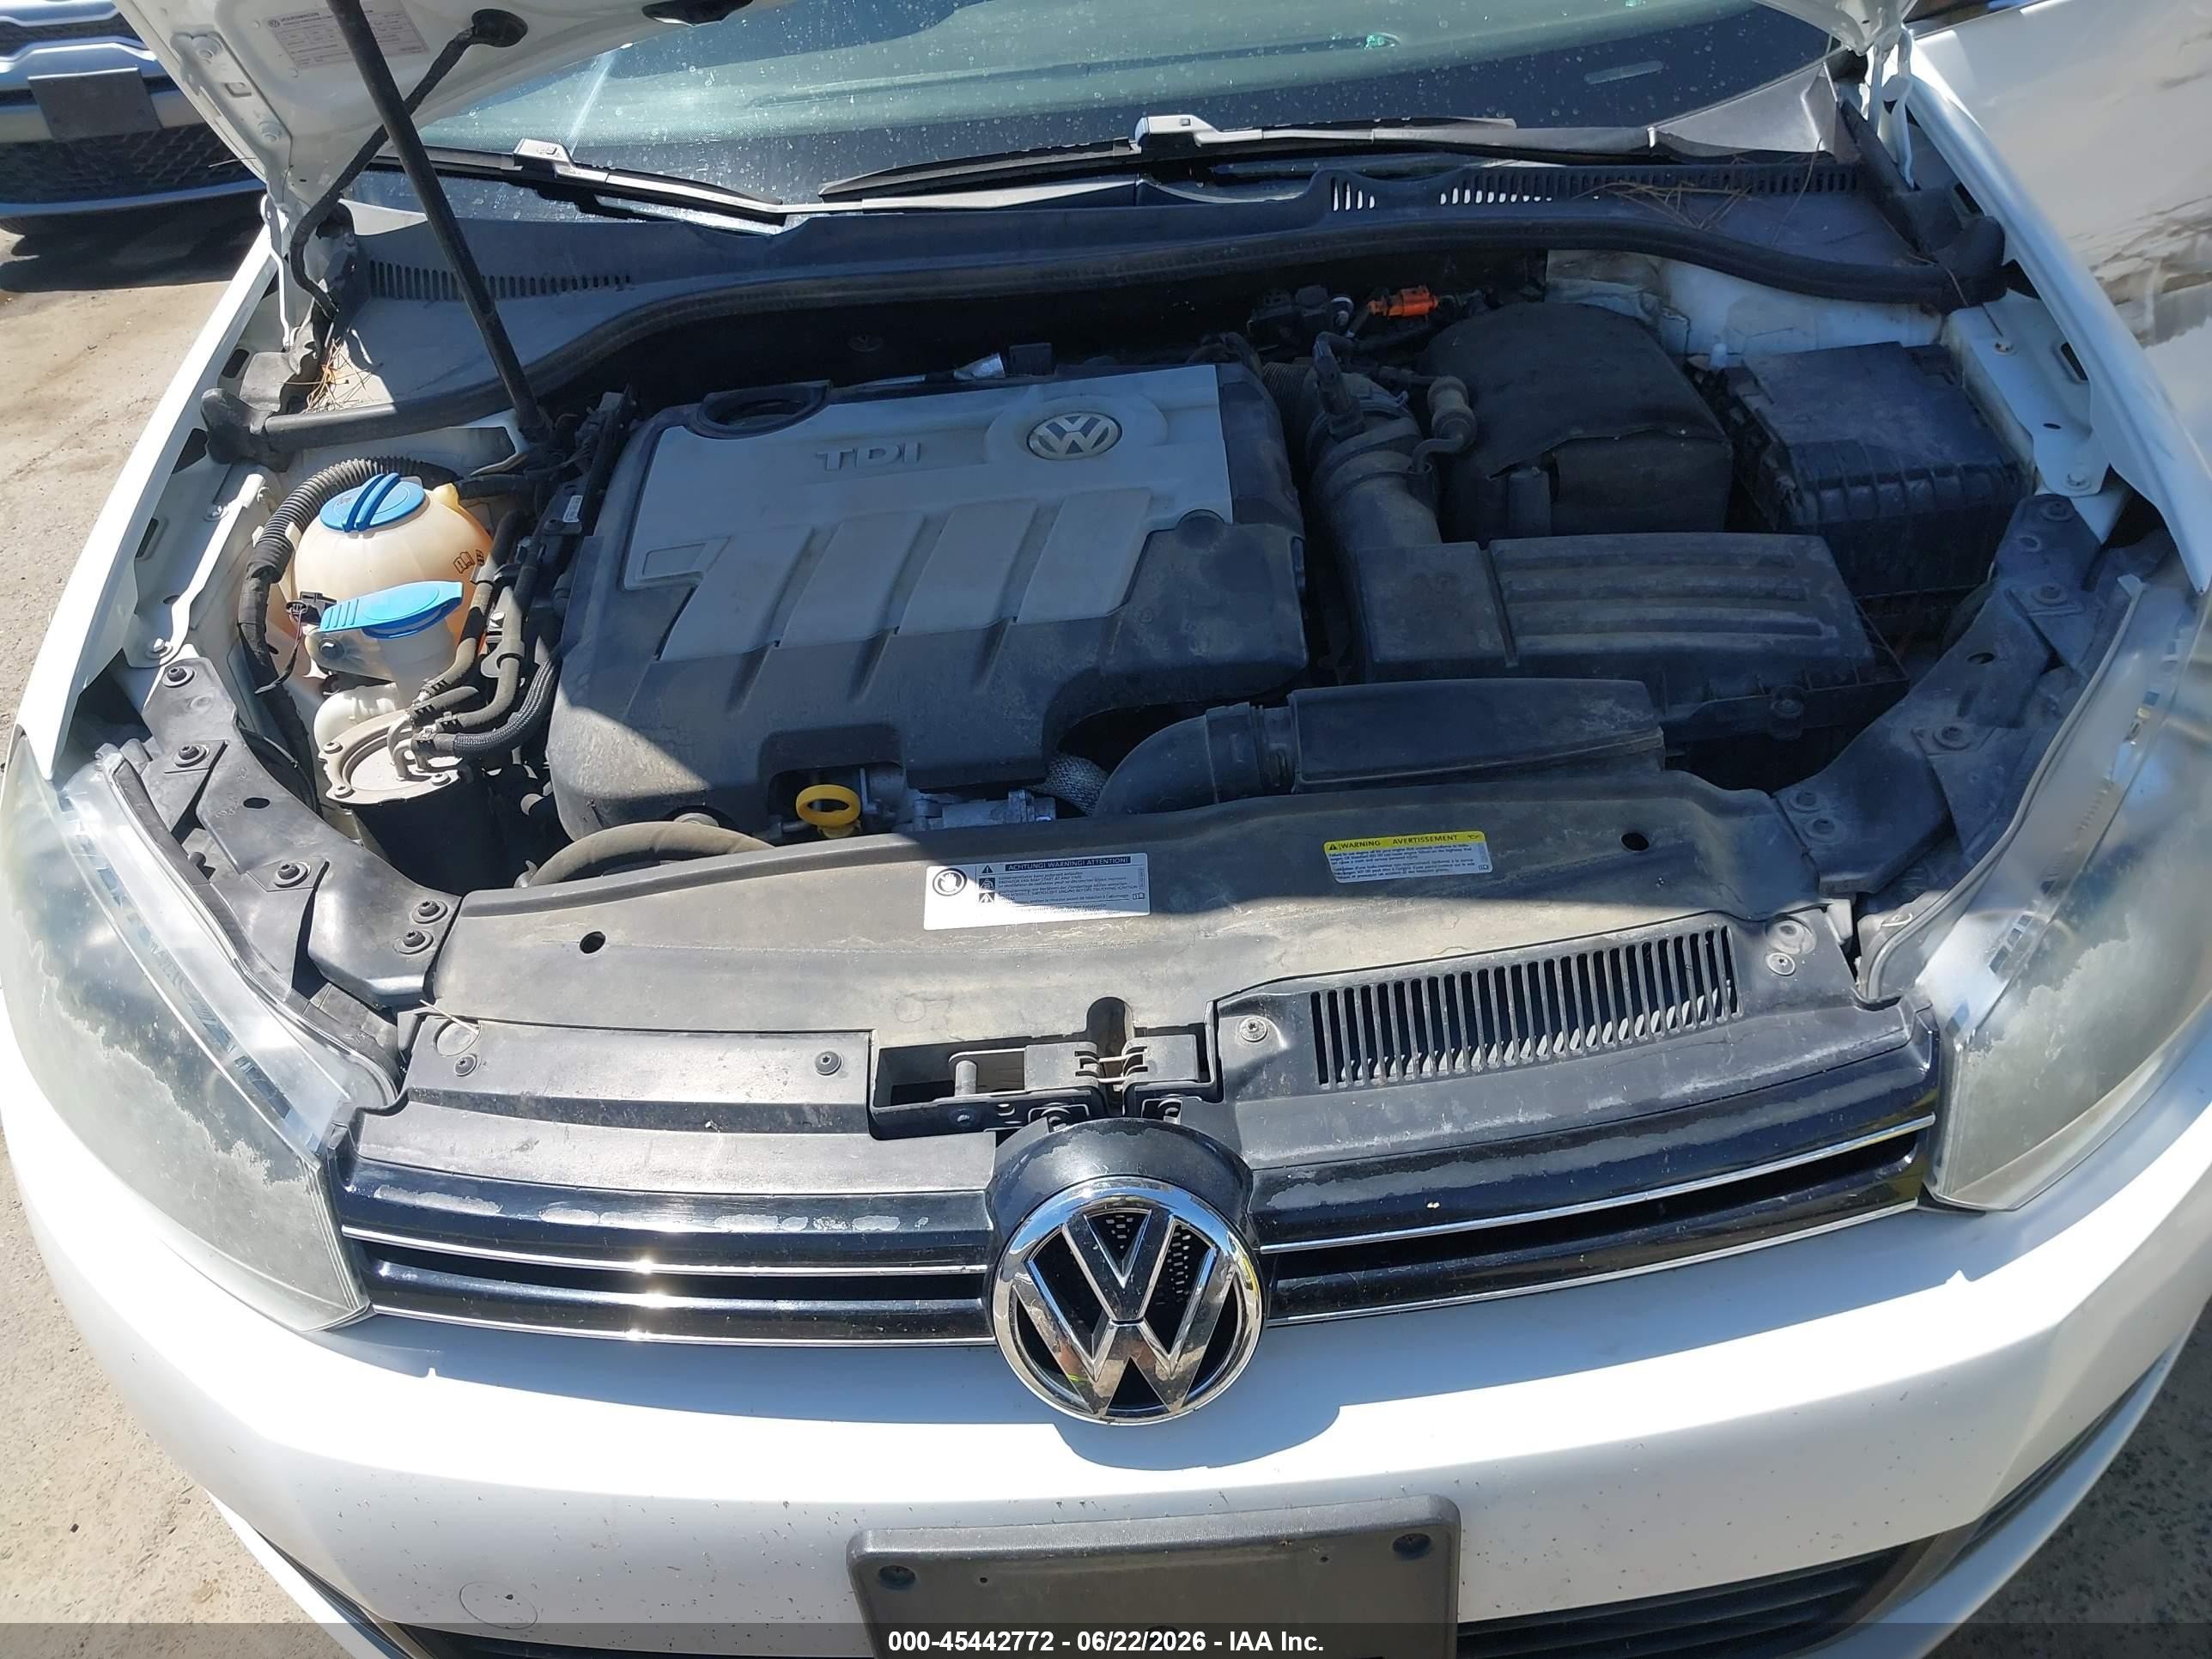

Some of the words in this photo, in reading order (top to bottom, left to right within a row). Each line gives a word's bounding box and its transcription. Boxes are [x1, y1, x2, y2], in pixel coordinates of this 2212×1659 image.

[817, 441, 921, 471] TDI
[1341, 840, 1382, 849] WARNING
[1392, 835, 1458, 845] AVERTISSEMENT
[1008, 862, 1048, 872] ACHTUNG!
[1048, 860, 1086, 868] WARNING!
[1086, 856, 1129, 866] ATTENTION!
